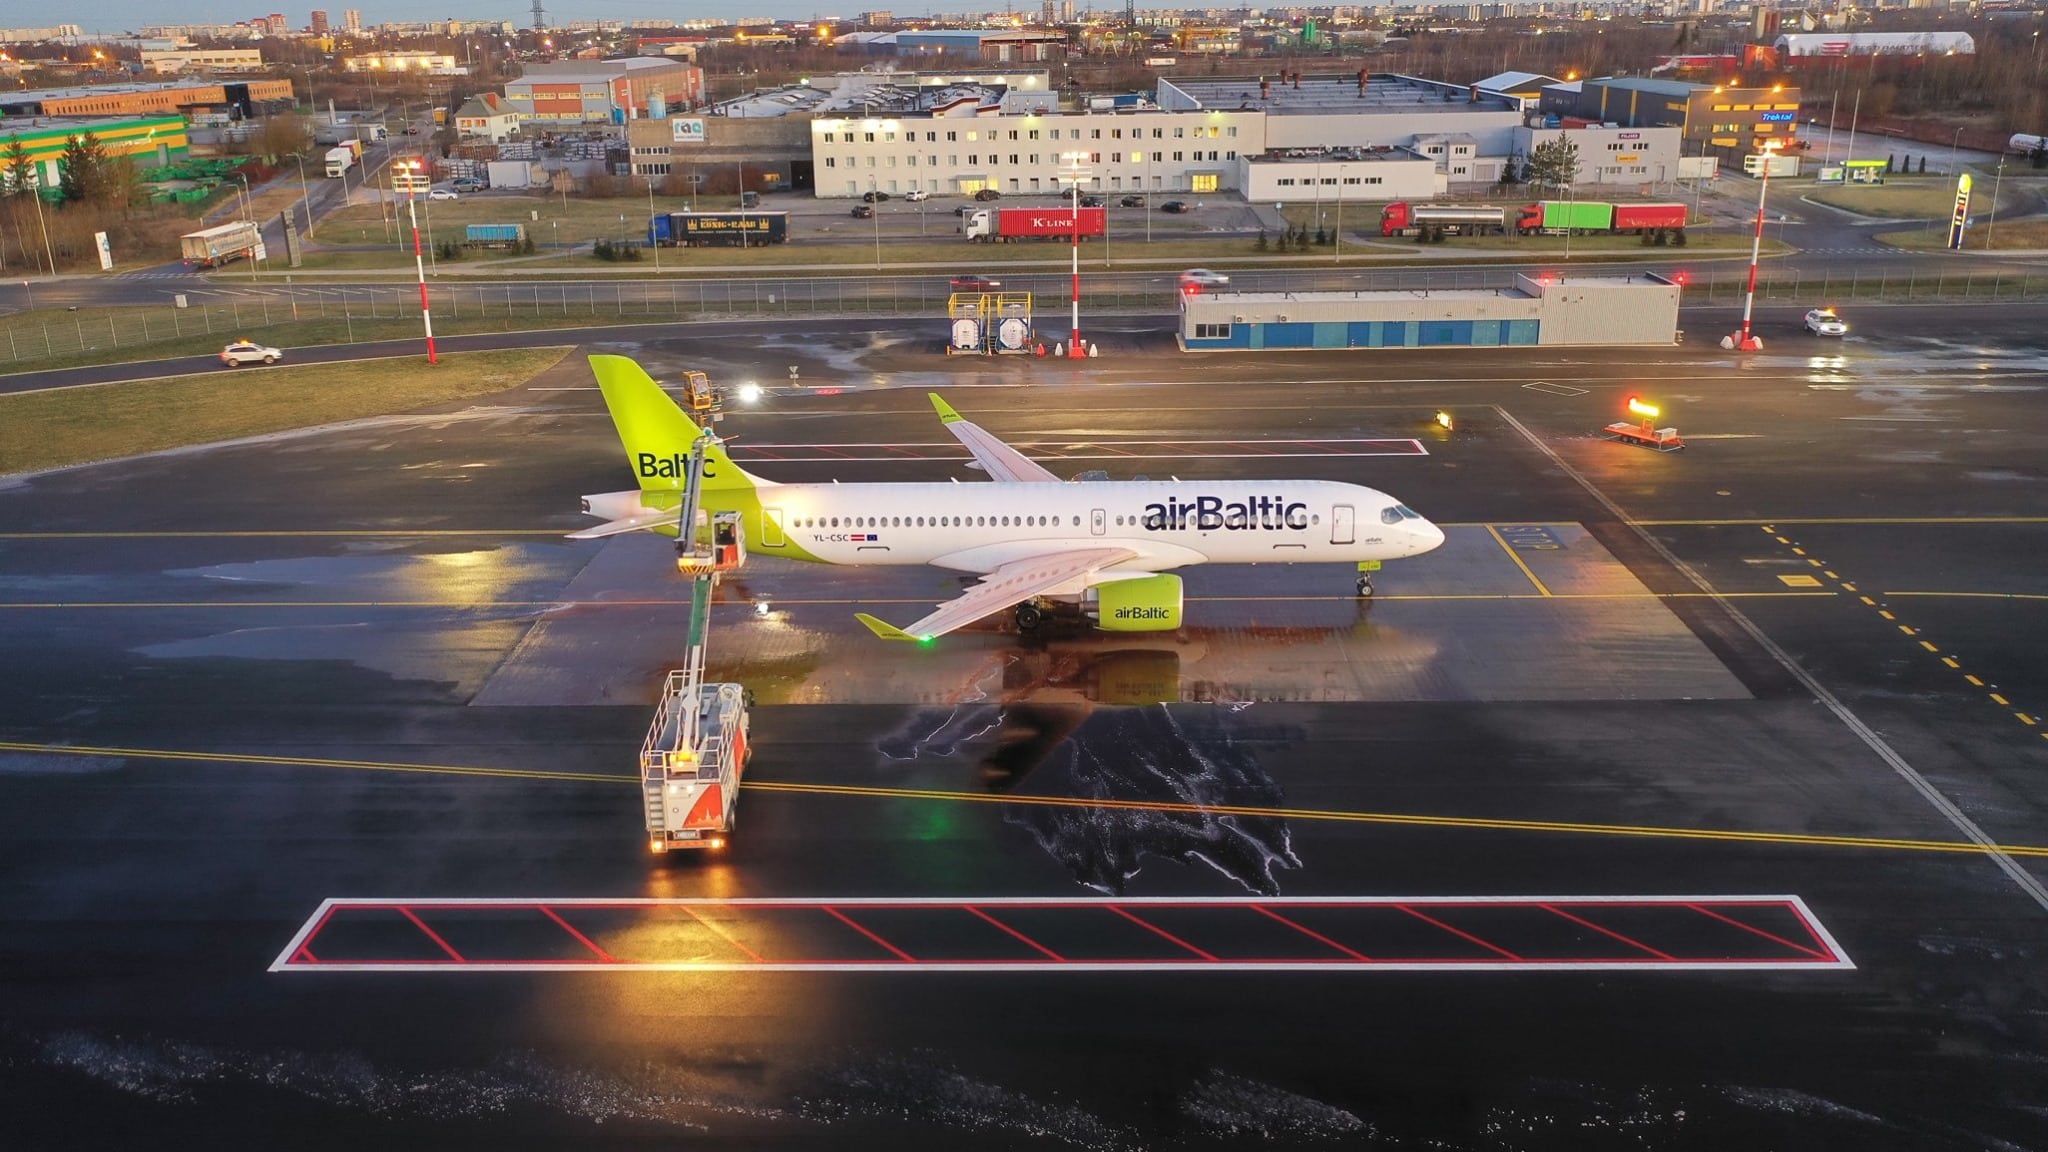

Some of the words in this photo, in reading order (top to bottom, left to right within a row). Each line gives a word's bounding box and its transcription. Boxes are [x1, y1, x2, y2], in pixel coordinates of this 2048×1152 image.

[638, 453, 716, 478] Baltc
[1145, 496, 1307, 531] airBaltic
[813, 534, 849, 542] YL-CSC
[1115, 607, 1170, 619] airBaltic
